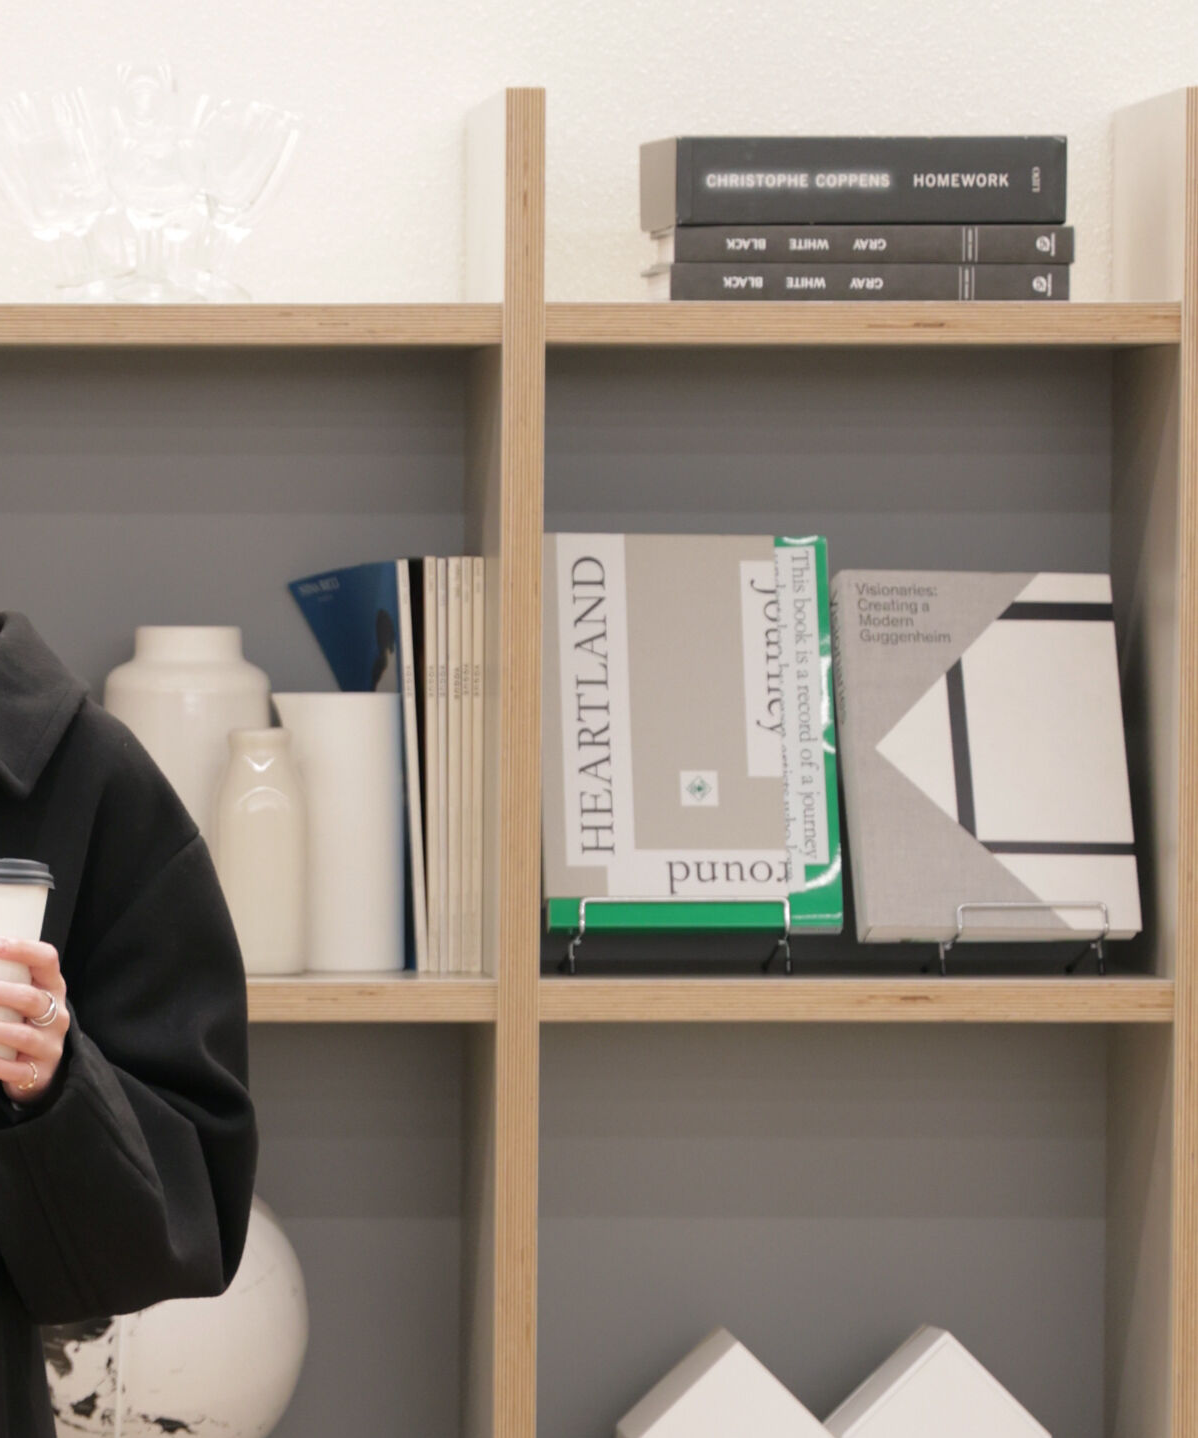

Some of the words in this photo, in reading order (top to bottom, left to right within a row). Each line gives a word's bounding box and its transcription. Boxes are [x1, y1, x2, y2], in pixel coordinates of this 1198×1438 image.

[705, 173, 809, 188] CHRISTOPHE
[815, 173, 890, 188] COPPENS
[913, 173, 1009, 188] HOMEWORK
[726, 238, 766, 250] BLACK
[789, 238, 829, 250] WHITE
[853, 238, 887, 250] GRAY
[723, 276, 763, 288] BLACK
[786, 276, 826, 289] WHITE
[850, 277, 883, 290] GRAY
[791, 550, 810, 592] This
[855, 583, 938, 597] Visionaries:
[858, 598, 918, 615] Creating
[922, 602, 930, 612] a
[793, 599, 813, 643] book
[859, 614, 914, 627] Modern
[859, 629, 951, 646] Guggenheim
[796, 652, 812, 664] is
[797, 670, 808, 681] a
[571, 556, 615, 855] HEARTLAND
[797, 686, 818, 742] record
[801, 749, 819, 770] of
[802, 775, 813, 785] a
[797, 792, 821, 861] journey
